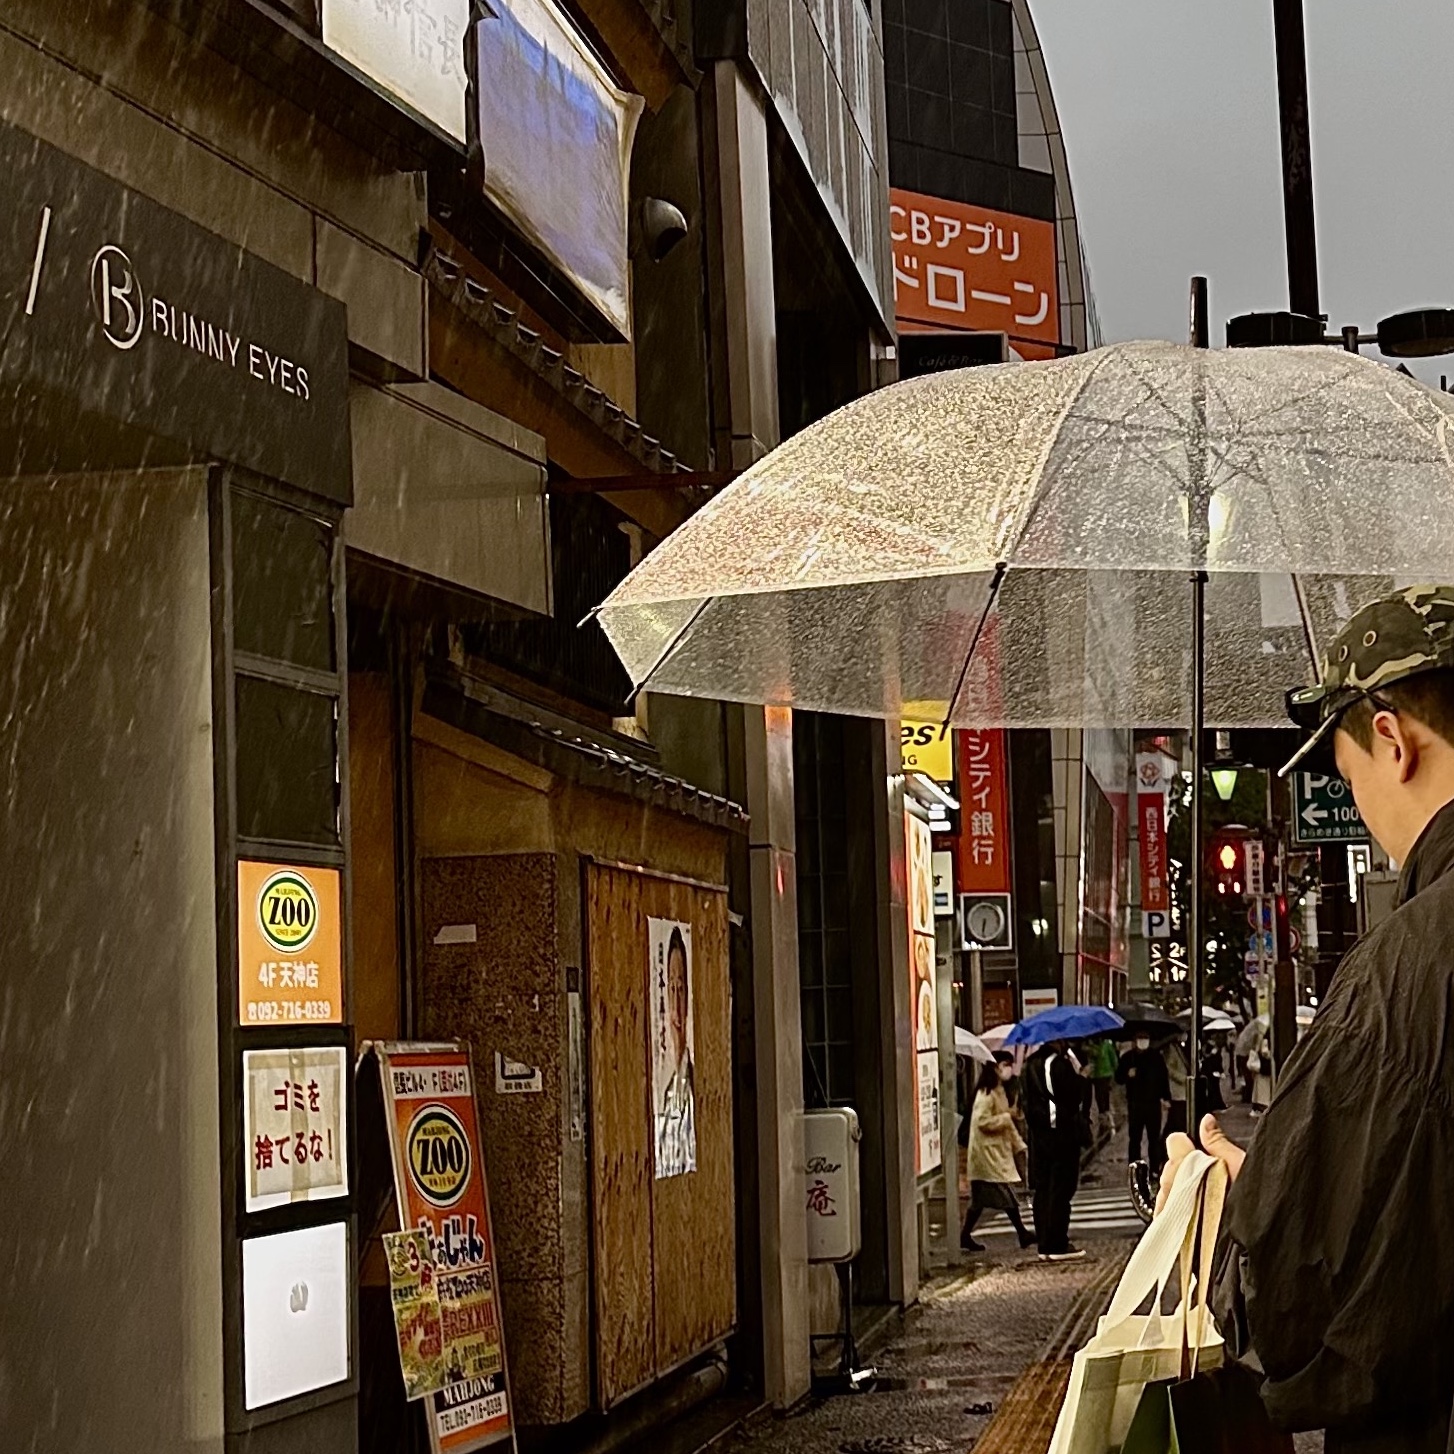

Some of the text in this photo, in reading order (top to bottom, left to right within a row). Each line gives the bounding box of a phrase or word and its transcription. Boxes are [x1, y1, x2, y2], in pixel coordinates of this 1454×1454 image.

[892, 252, 1048, 325] ドローン
[152, 298, 309, 400] BUNNY EYES
[268, 896, 311, 928] ZOO
[1148, 912, 1165, 937] P
[259, 961, 319, 988] 4F 天神店
[257, 1001, 331, 1020] 092-716-0339
[274, 1080, 320, 1112] ゴミを
[255, 1128, 333, 1170] 捨てるな!
[416, 1135, 464, 1177] ZOO
[805, 1156, 842, 1175] Bar
[806, 1180, 837, 1216] 庵
[443, 1375, 495, 1406] MAHJONG
